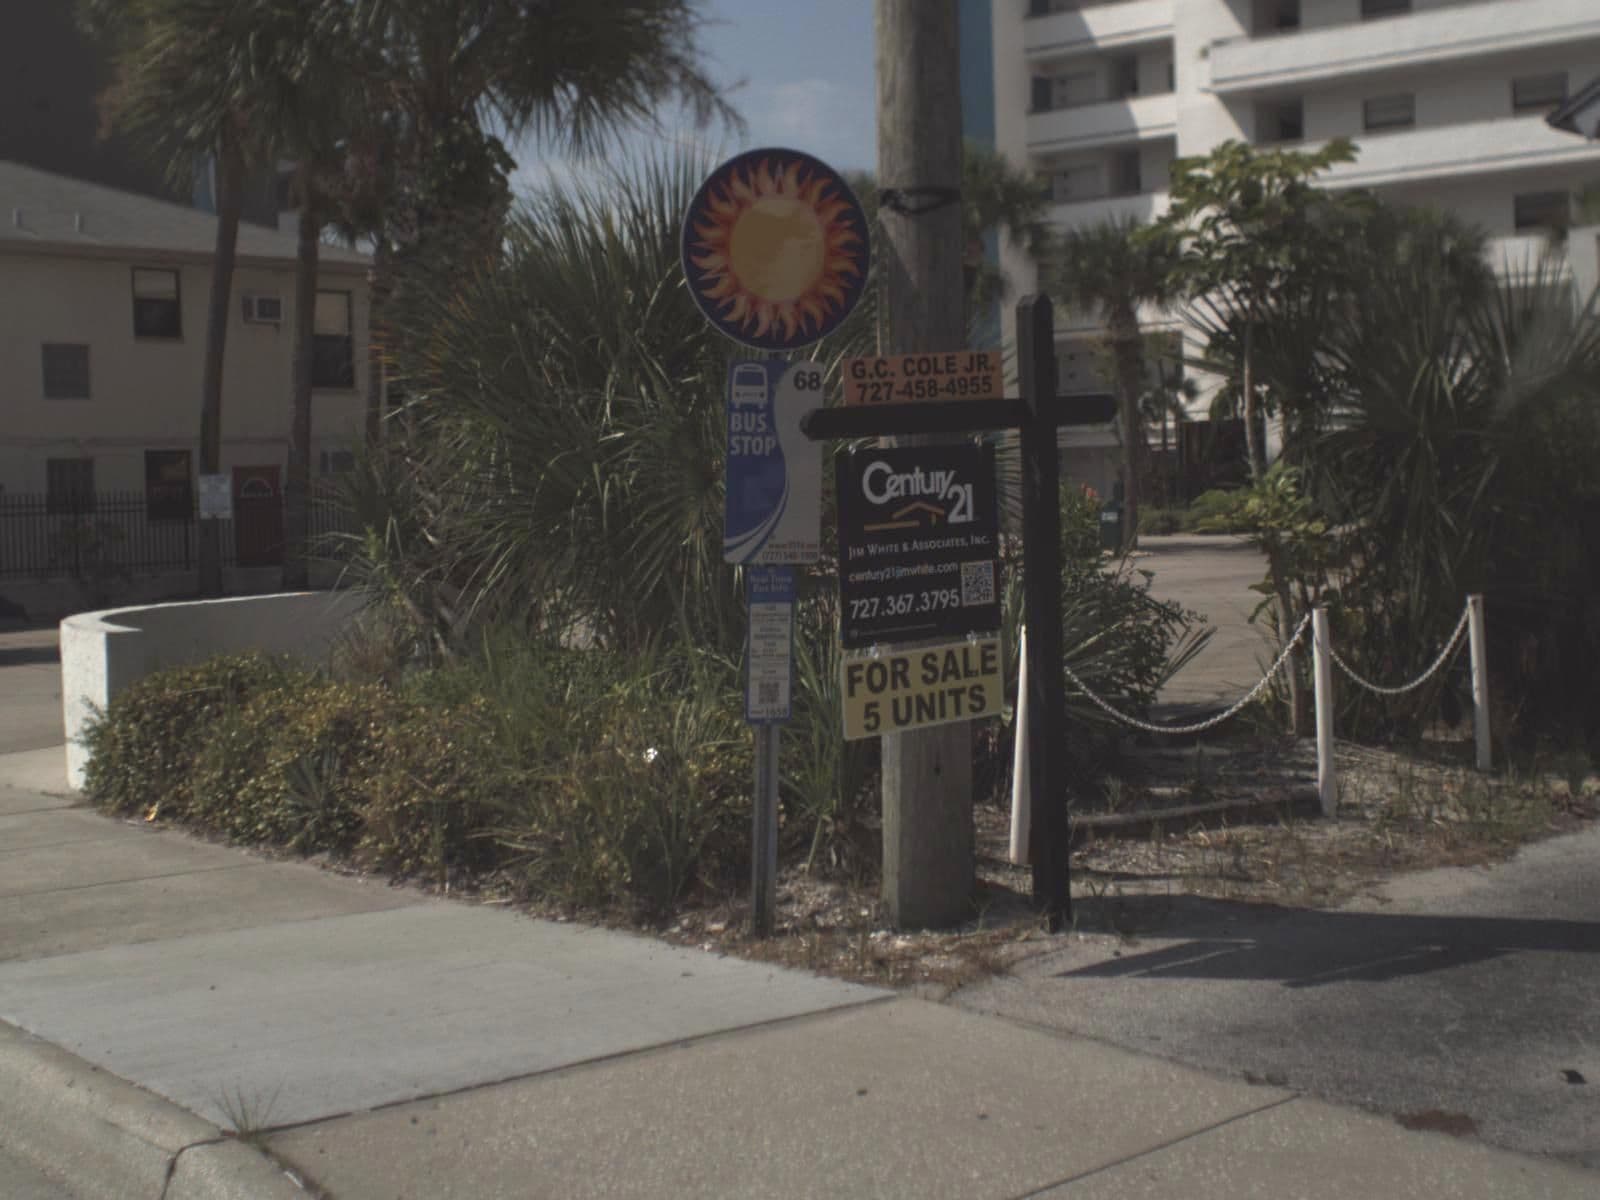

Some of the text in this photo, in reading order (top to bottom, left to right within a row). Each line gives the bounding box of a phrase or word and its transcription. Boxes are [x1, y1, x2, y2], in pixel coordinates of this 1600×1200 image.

[852, 354, 995, 380] G.C. COLE JR.
[795, 371, 821, 391] 68
[856, 376, 992, 402] 727-458-4955
[731, 413, 767, 432] BUS
[731, 436, 777, 456] STOP
[862, 461, 974, 524] Century 21
[903, 543, 910, 552] &
[850, 589, 960, 619] 727.367.3795
[847, 644, 998, 698] FOR SALE
[864, 685, 987, 732] 5 UNITS
